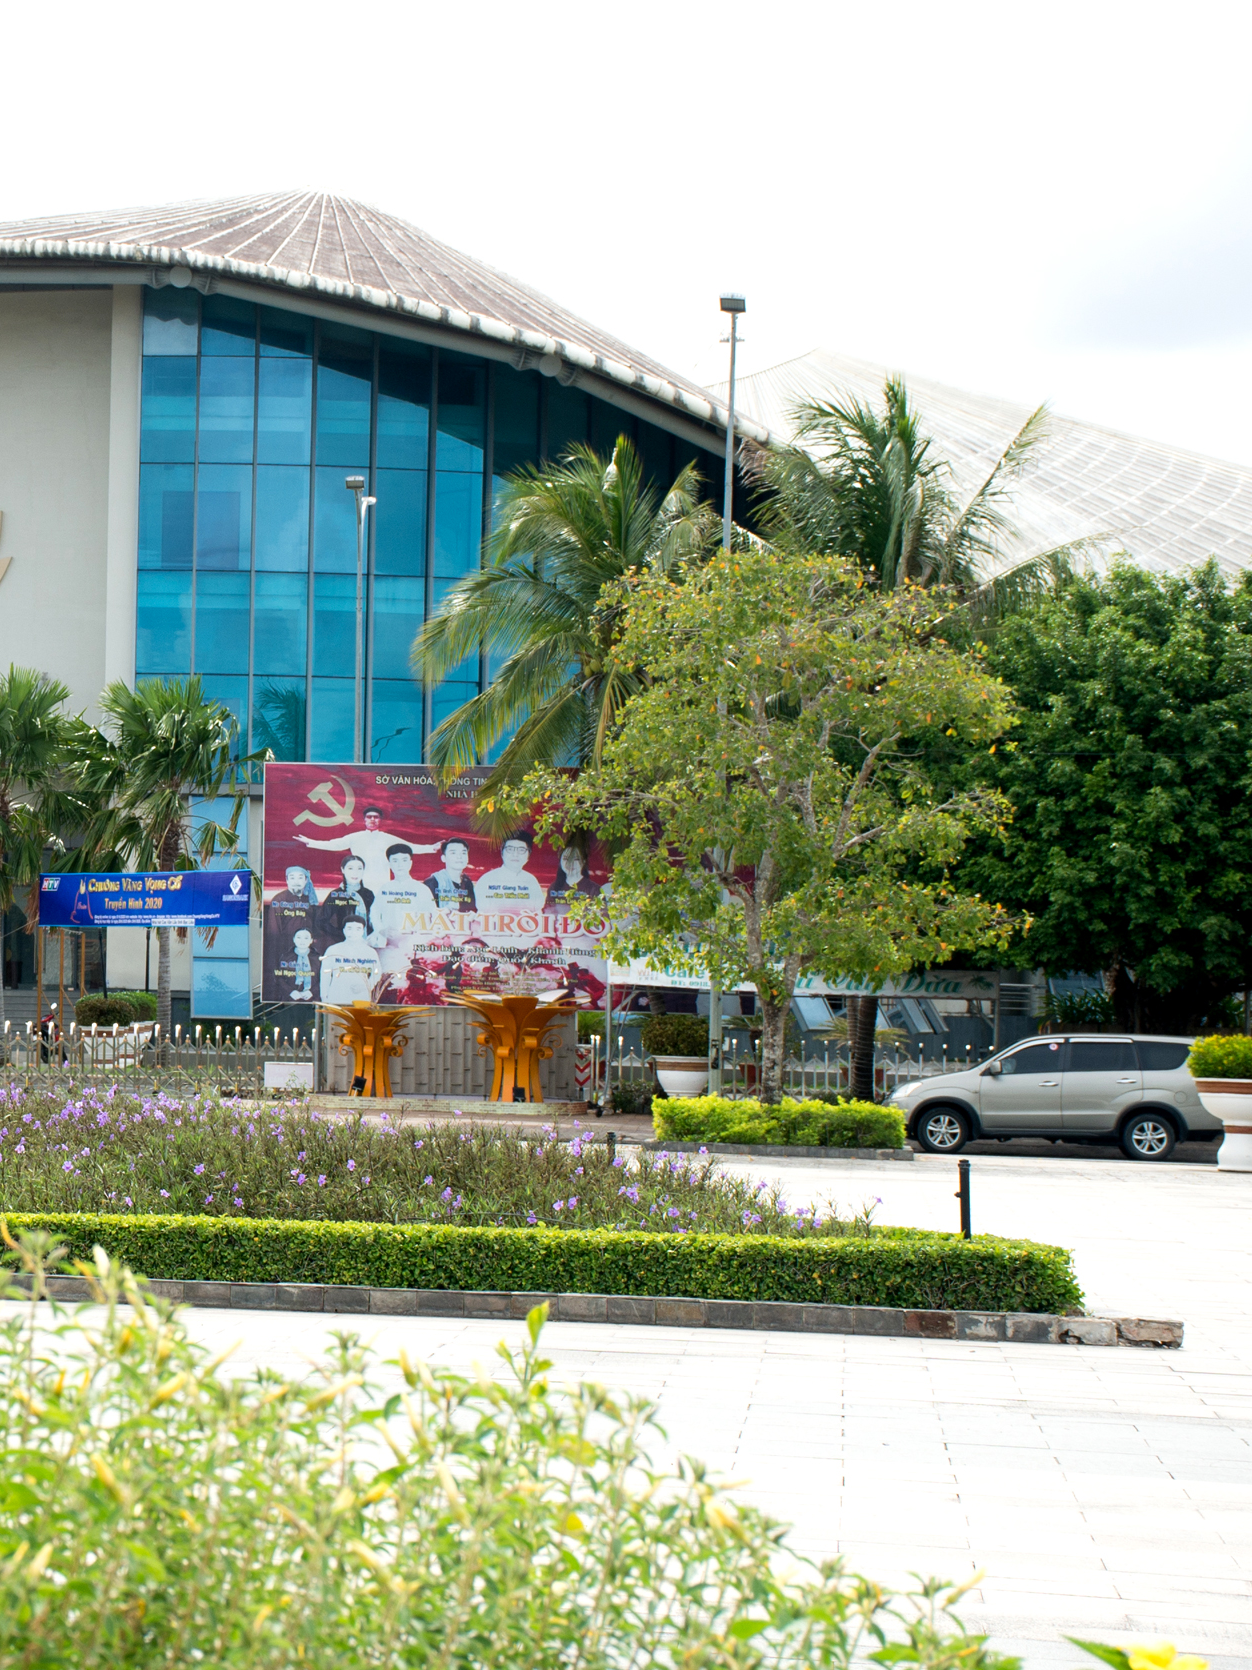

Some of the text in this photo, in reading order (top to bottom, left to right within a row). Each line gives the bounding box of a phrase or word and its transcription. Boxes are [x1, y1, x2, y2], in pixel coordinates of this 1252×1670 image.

[375, 776, 390, 784] SỞ
[392, 775, 411, 785] VĂN
[446, 788, 468, 799] NHÀ
[42, 879, 60, 890] HTV
[105, 896, 127, 911] Truyền
[144, 897, 163, 909] 2020
[401, 909, 470, 936] MẶT
[476, 910, 555, 935] TRỜI
[413, 944, 438, 953] Kịch
